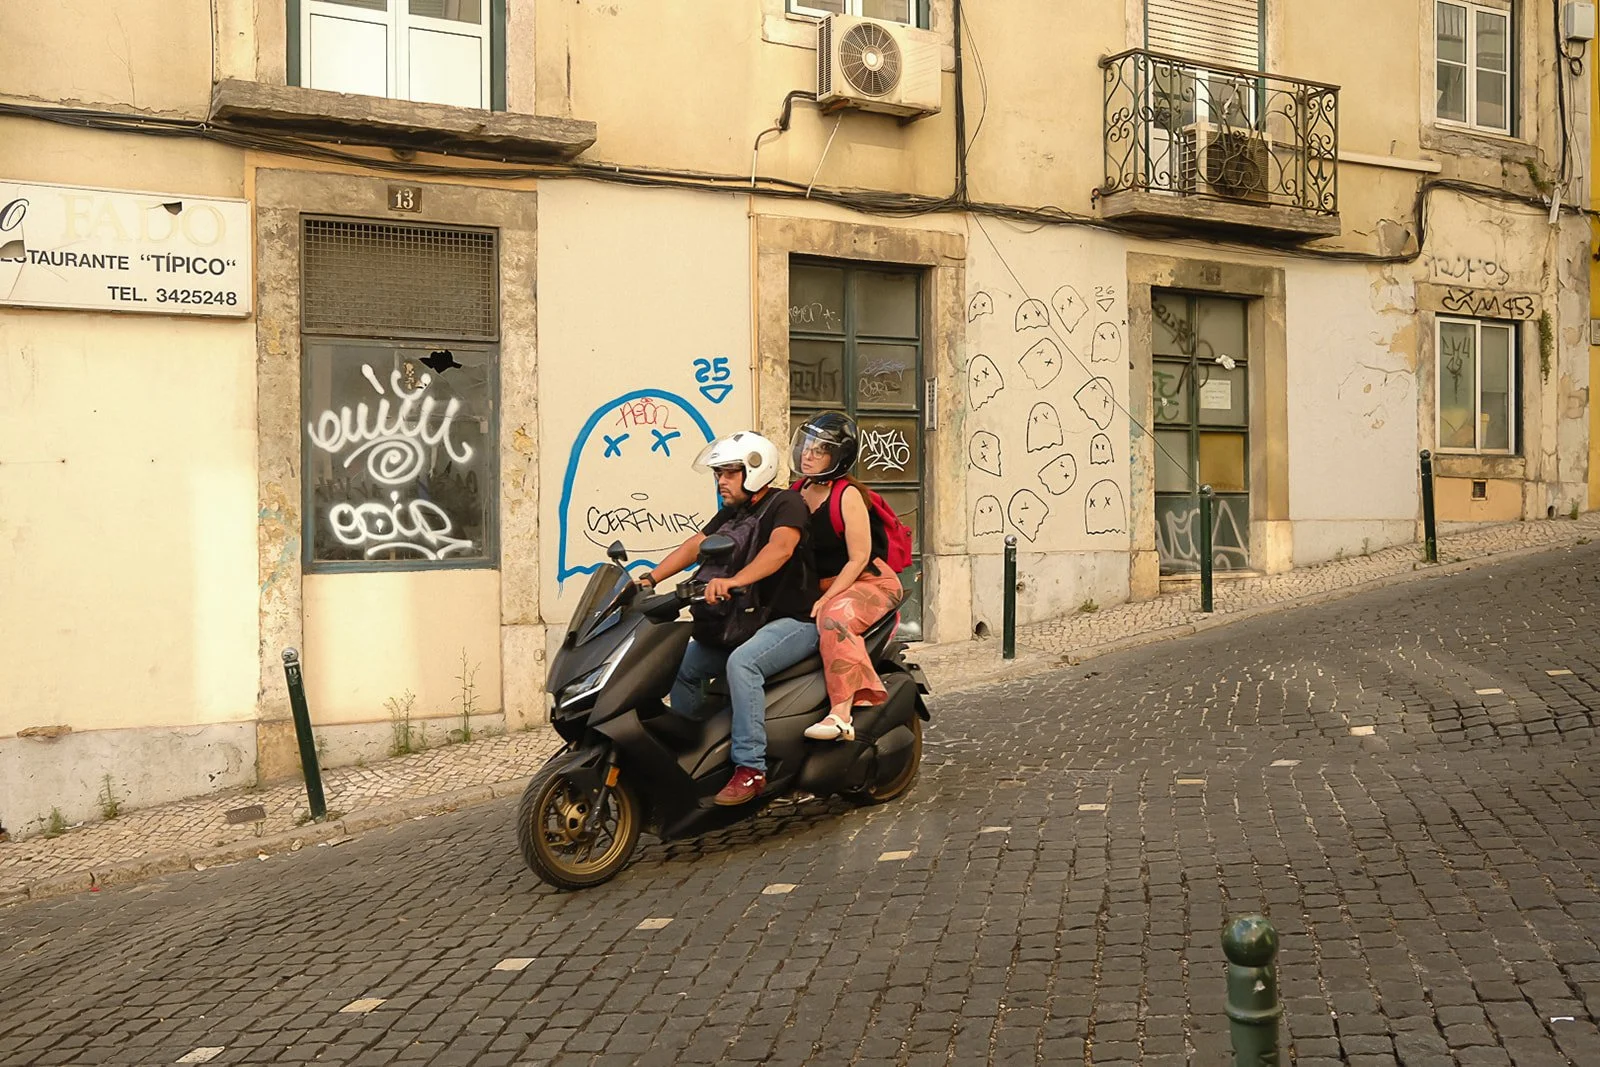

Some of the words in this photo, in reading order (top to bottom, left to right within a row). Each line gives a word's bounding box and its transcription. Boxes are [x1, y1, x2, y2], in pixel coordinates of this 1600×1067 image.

[395, 188, 414, 209] 13
[107, 285, 148, 302] TEL.
[156, 287, 238, 306] 3425248
